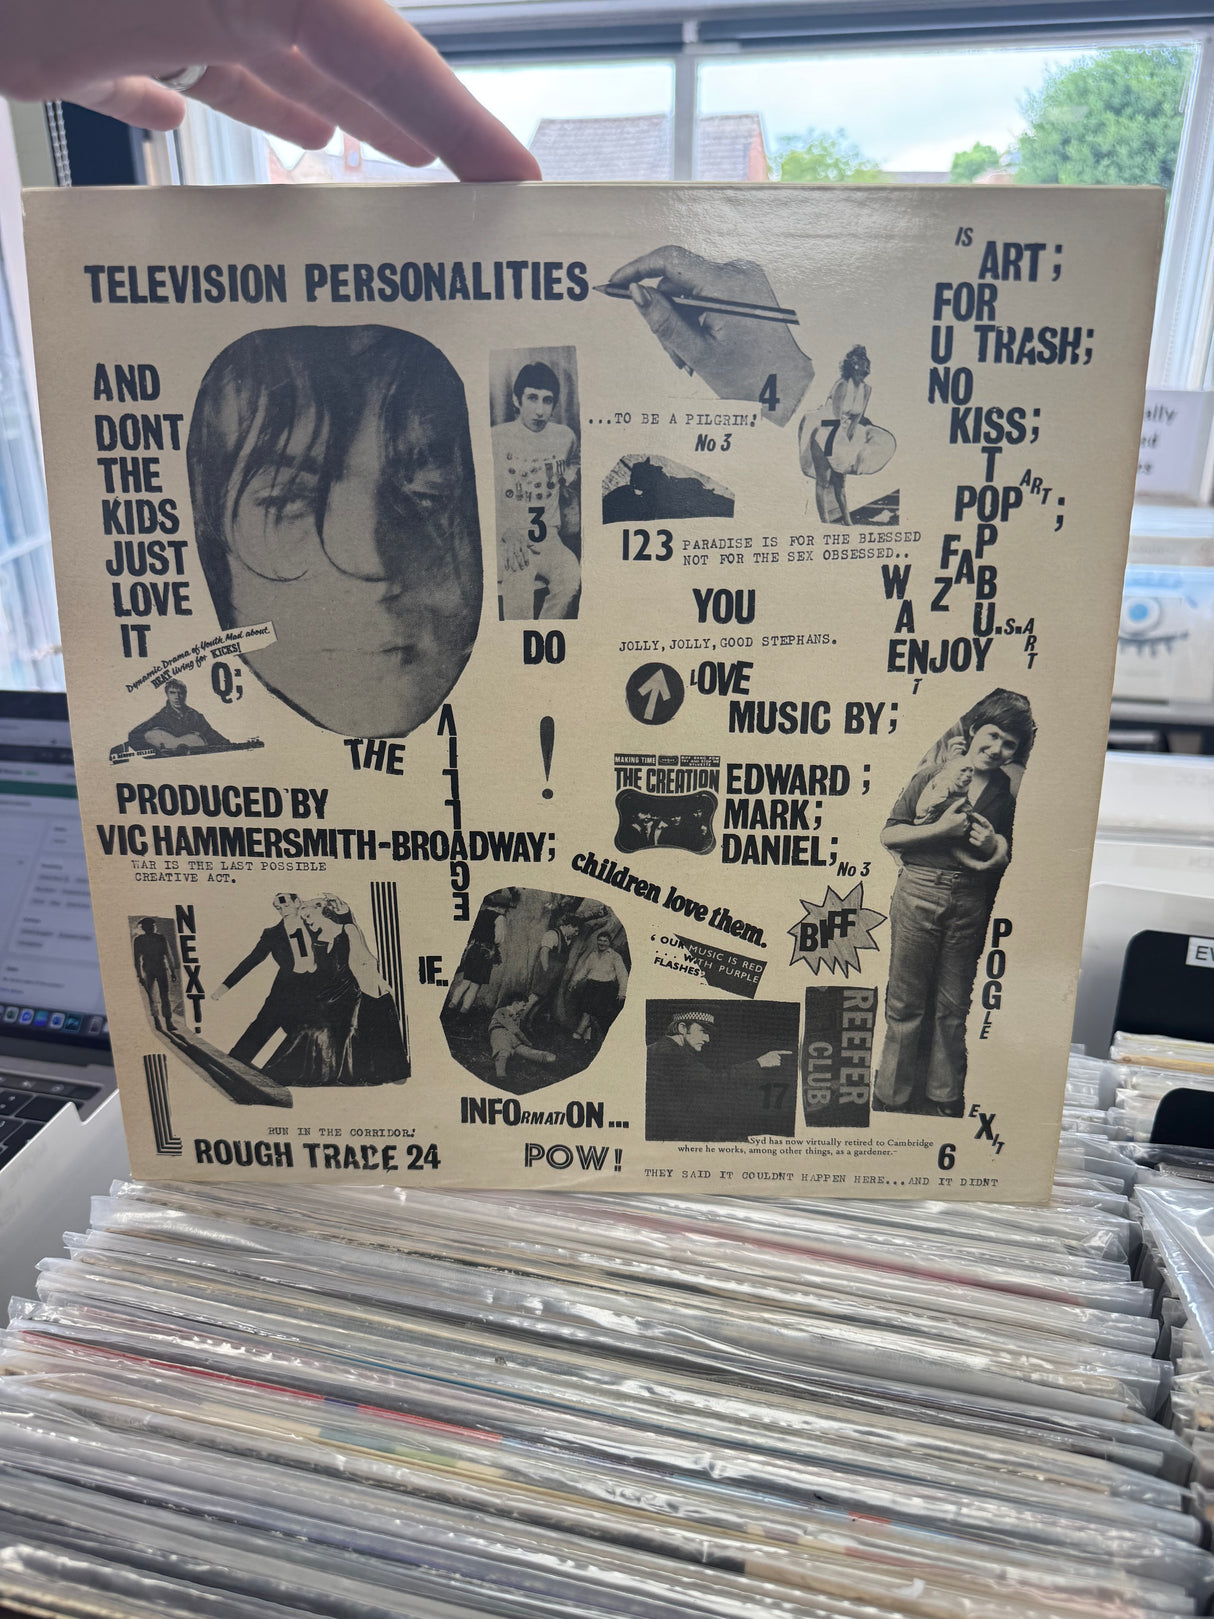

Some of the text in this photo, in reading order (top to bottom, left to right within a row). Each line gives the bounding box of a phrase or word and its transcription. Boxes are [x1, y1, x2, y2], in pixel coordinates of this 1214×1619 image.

[954, 226, 974, 247] IS
[84, 260, 590, 303] TELEVISION PERSONALITIES
[932, 281, 999, 322] FOR
[930, 324, 954, 365] U
[93, 362, 161, 403] AND
[758, 373, 780, 412] 4
[927, 366, 974, 406] NO
[94, 413, 184, 452] DONT
[641, 412, 660, 425] BE
[669, 413, 678, 424] A
[694, 432, 732, 453] No 3
[820, 418, 841, 457] 7
[96, 456, 164, 494] THE
[101, 497, 180, 536] KIDS
[954, 485, 1024, 523] POP
[527, 506, 548, 543] 3
[682, 531, 922, 551] PARADISE IS FOR THE BLESSED
[105, 540, 189, 577] JUST
[622, 528, 674, 562] 123
[682, 554, 710, 566] NOT
[719, 553, 745, 565] FOR
[753, 552, 780, 564] THE
[787, 551, 814, 563] SEX
[111, 581, 193, 618] LOVE
[691, 587, 757, 625] YOU
[120, 623, 152, 658] IT
[523, 629, 567, 665] DO
[720, 637, 754, 649] GOOD
[761, 634, 838, 648] STEPHANS.
[887, 636, 994, 675] ENJOY
[125, 664, 163, 694] Dynamic
[160, 650, 192, 670] Drama
[200, 636, 225, 651] Youth
[225, 630, 245, 643] Mad
[245, 625, 271, 638] about
[171, 658, 195, 677] living
[195, 655, 208, 669] for
[210, 642, 242, 659] KICKS!
[689, 660, 754, 697] LOVE
[728, 700, 831, 735] MUSIC
[343, 738, 406, 776] THE
[614, 755, 639, 764] MAKING
[641, 757, 656, 765] TIME
[613, 767, 720, 795] THE CREATION
[116, 782, 329, 820] PRODUCED BY
[96, 823, 149, 858] VIC
[131, 859, 327, 872] WAR IS THE LAST POSSIBLE
[135, 872, 237, 884] CREATIVE ACT.
[836, 860, 872, 878] No 3
[571, 851, 768, 949] children love them.
[289, 928, 308, 958] 1
[688, 944, 725, 961] MUSIC
[727, 956, 738, 966] IS
[742, 960, 764, 973] RED
[718, 964, 761, 984] PURPLE
[839, 988, 875, 1105] REEFER
[806, 1041, 834, 1105] CLUB
[759, 1082, 790, 1110] 17
[267, 1126, 289, 1137] RUN
[298, 1126, 311, 1137] IN
[319, 1127, 342, 1138] THE
[749, 1136, 934, 1149] Syd has now virtually retired to Cambridge
[967, 1103, 1006, 1156] EXIT
[193, 1137, 295, 1168] ROUGH
[406, 1142, 442, 1171] 24
[524, 1142, 624, 1173] POW!
[677, 1144, 703, 1153] where
[705, 1144, 716, 1153] he
[718, 1145, 747, 1155] works,
[748, 1147, 778, 1156] among
[779, 1147, 802, 1156] other
[804, 1147, 834, 1158] things,
[937, 1142, 957, 1171] 6
[644, 1168, 673, 1178] THEY
[681, 1169, 712, 1180] SAID
[719, 1170, 734, 1180] IT
[741, 1171, 794, 1182] COULDNT
[800, 1173, 846, 1184] HAPPEN
[937, 1176, 953, 1187] IT
[959, 1177, 999, 1188] DIDNT
